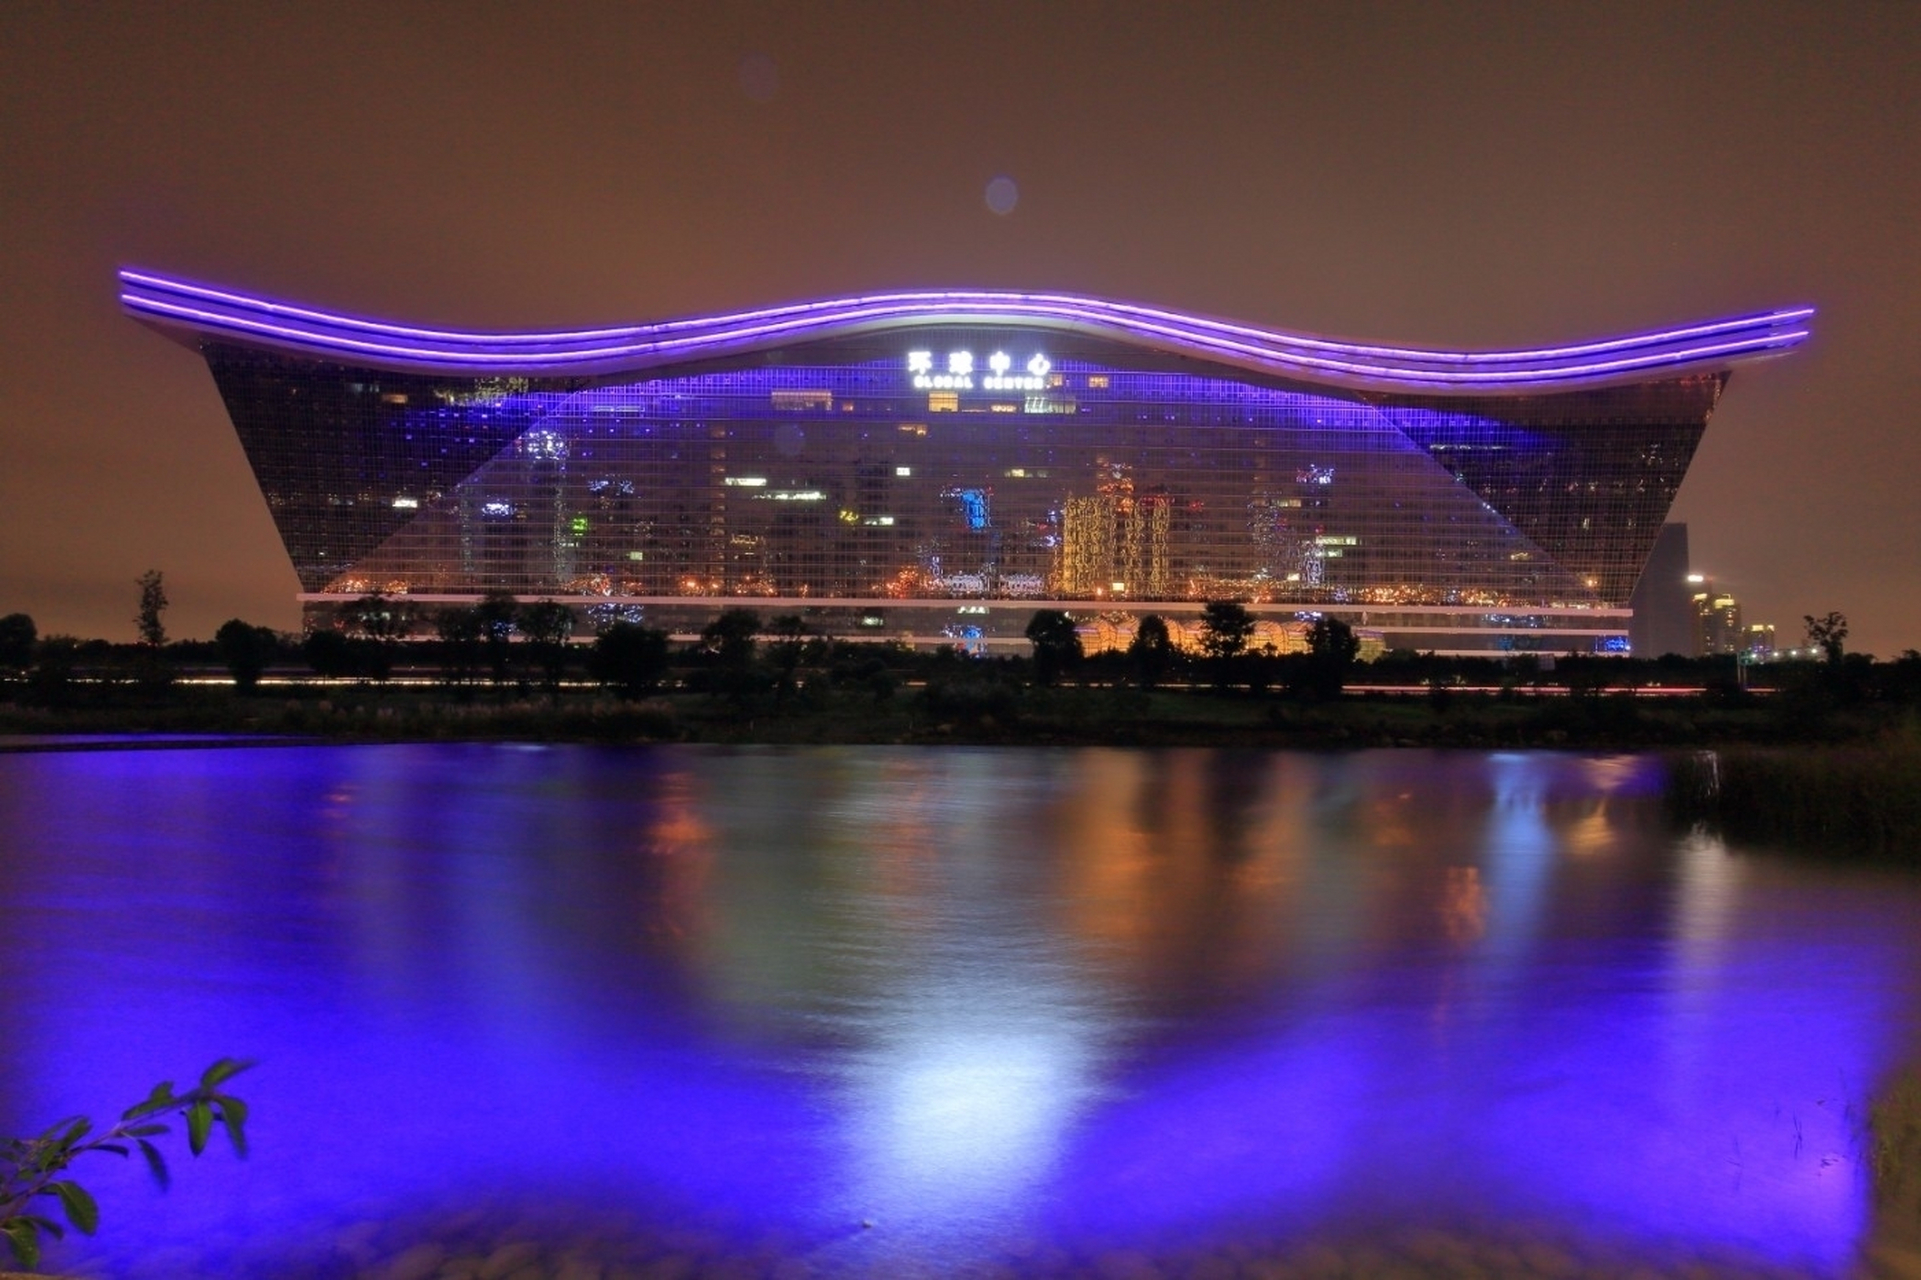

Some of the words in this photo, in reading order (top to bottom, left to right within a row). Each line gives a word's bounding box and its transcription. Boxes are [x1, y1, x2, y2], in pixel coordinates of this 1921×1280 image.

[908, 351, 1051, 375] 环球中心
[913, 375, 974, 389] GLOBAL
[983, 376, 1044, 390] CENTER
